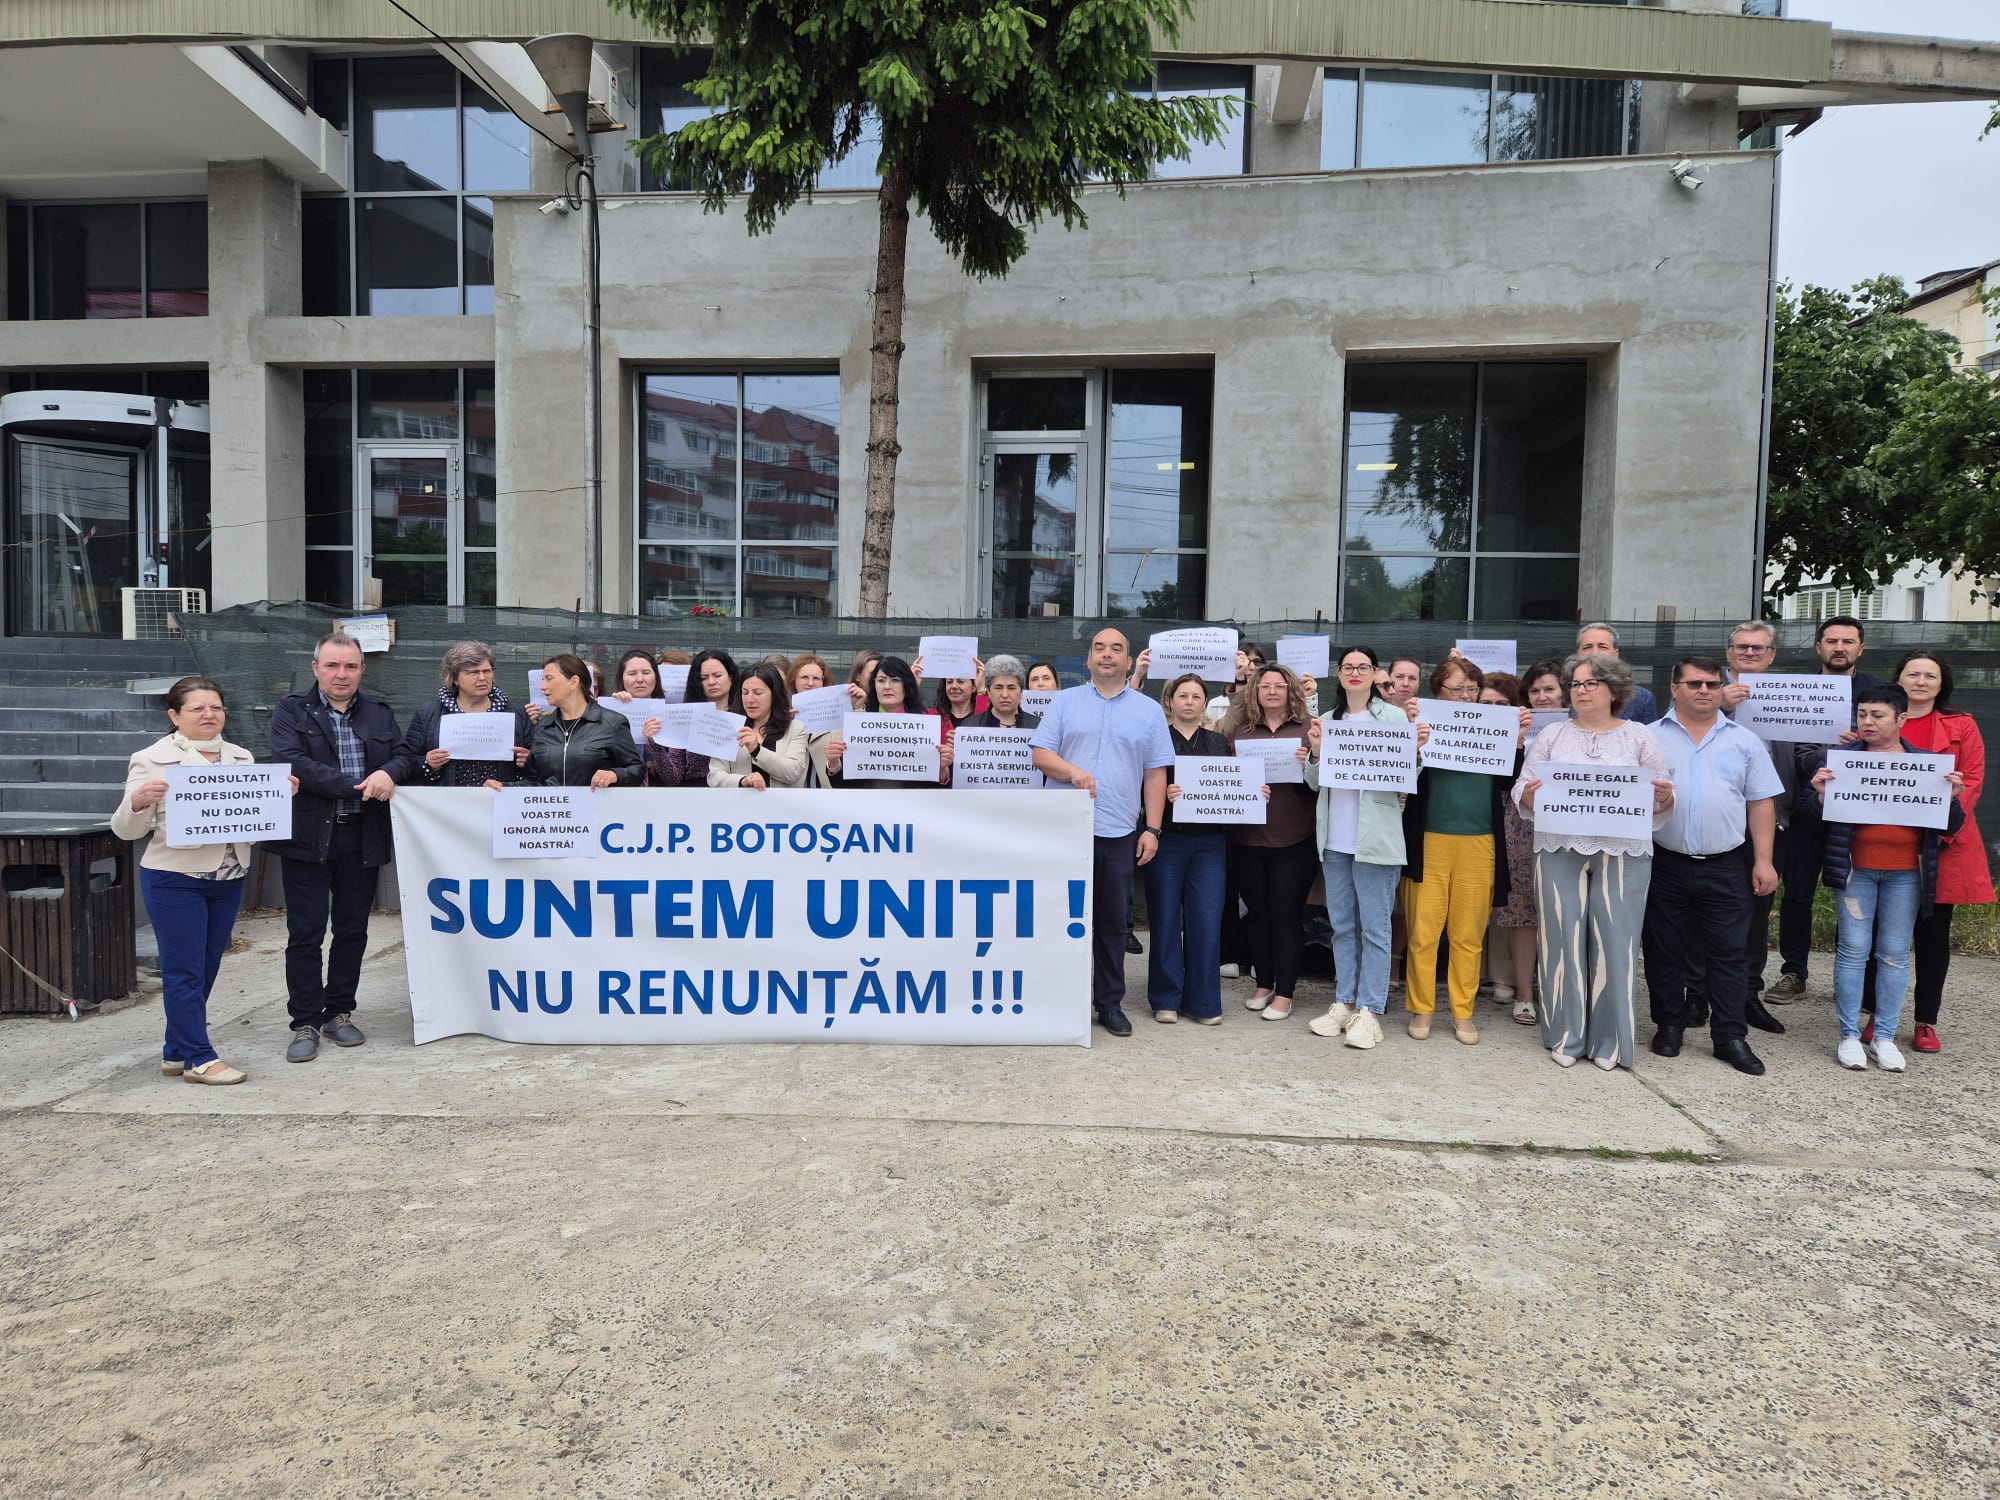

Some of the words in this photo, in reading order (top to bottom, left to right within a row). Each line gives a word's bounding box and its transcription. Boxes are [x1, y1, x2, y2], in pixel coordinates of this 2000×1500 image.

[1790, 682, 1819, 690] NOUĂ
[1762, 705, 1810, 714] NOASTRĂ
[1453, 711, 1483, 720] STOP
[1752, 716, 1834, 727] DISPREȚUIEȘTE!
[1328, 728, 1355, 737] FĂRĂ
[1357, 730, 1412, 739] PERSONAL
[1429, 723, 1509, 737] NECHITĂȚILOR
[850, 736, 935, 747] PROFESIONIȘTII,
[960, 734, 985, 743] FĂRĂ
[988, 735, 1031, 744] PERSON
[1339, 743, 1384, 752] MOTIVAT
[1387, 745, 1402, 754] NU
[1434, 739, 1496, 751] SALARIALE!
[869, 750, 884, 758] NU
[887, 750, 915, 758] DOAR
[970, 749, 1012, 757] MOTIVAT
[1014, 750, 1029, 758] NU
[1423, 751, 1452, 761] VREM
[1454, 754, 1506, 767] RESPECT!
[857, 764, 928, 772] STATISTICILE!
[960, 762, 994, 770] EXISTĂ
[1201, 765, 1241, 773] GRILELE
[1327, 757, 1366, 767] EXISTĂ
[1368, 759, 1411, 770] SERVICII
[1844, 760, 1886, 770] GRILE
[1890, 762, 1936, 772] EGALE
[188, 773, 270, 785] CONSULTAȚI
[982, 776, 1030, 785] CALITATE!
[1199, 779, 1243, 787] VOASTRE
[1352, 773, 1405, 784] CALITATE!
[1552, 772, 1591, 781] GRILE
[1595, 774, 1638, 783] EGALE
[1861, 777, 1917, 788] PENTRU
[175, 789, 284, 801] PROFESIONIȘTII,
[1183, 792, 1220, 801] IGNORĂ
[1568, 788, 1621, 798] PENTRU
[523, 796, 570, 804] GRILELE
[1834, 792, 1888, 804] FUNCȚII
[1892, 794, 1942, 806] EGALE!
[201, 808, 220, 818] NU
[224, 806, 261, 817] DOAR
[521, 811, 572, 819] VOASTRE
[1196, 806, 1245, 815] NOASTRĂ!
[1543, 804, 1595, 816] FUNCȚII
[1599, 805, 1646, 817] EGALE!
[185, 822, 276, 835] STATISTICILE!
[503, 825, 546, 834] IGNORĂ
[519, 840, 574, 849] NOASTRĂ!
[600, 823, 695, 853] C.J.P.
[710, 823, 913, 862] BOTOȘANI
[427, 878, 774, 939] SUNTEM
[806, 879, 1034, 957] UNIȚI
[1067, 880, 1086, 939] !
[488, 969, 573, 1014] NU
[598, 957, 946, 1028] RENUNȚĂM
[971, 970, 1023, 1015] !!!
